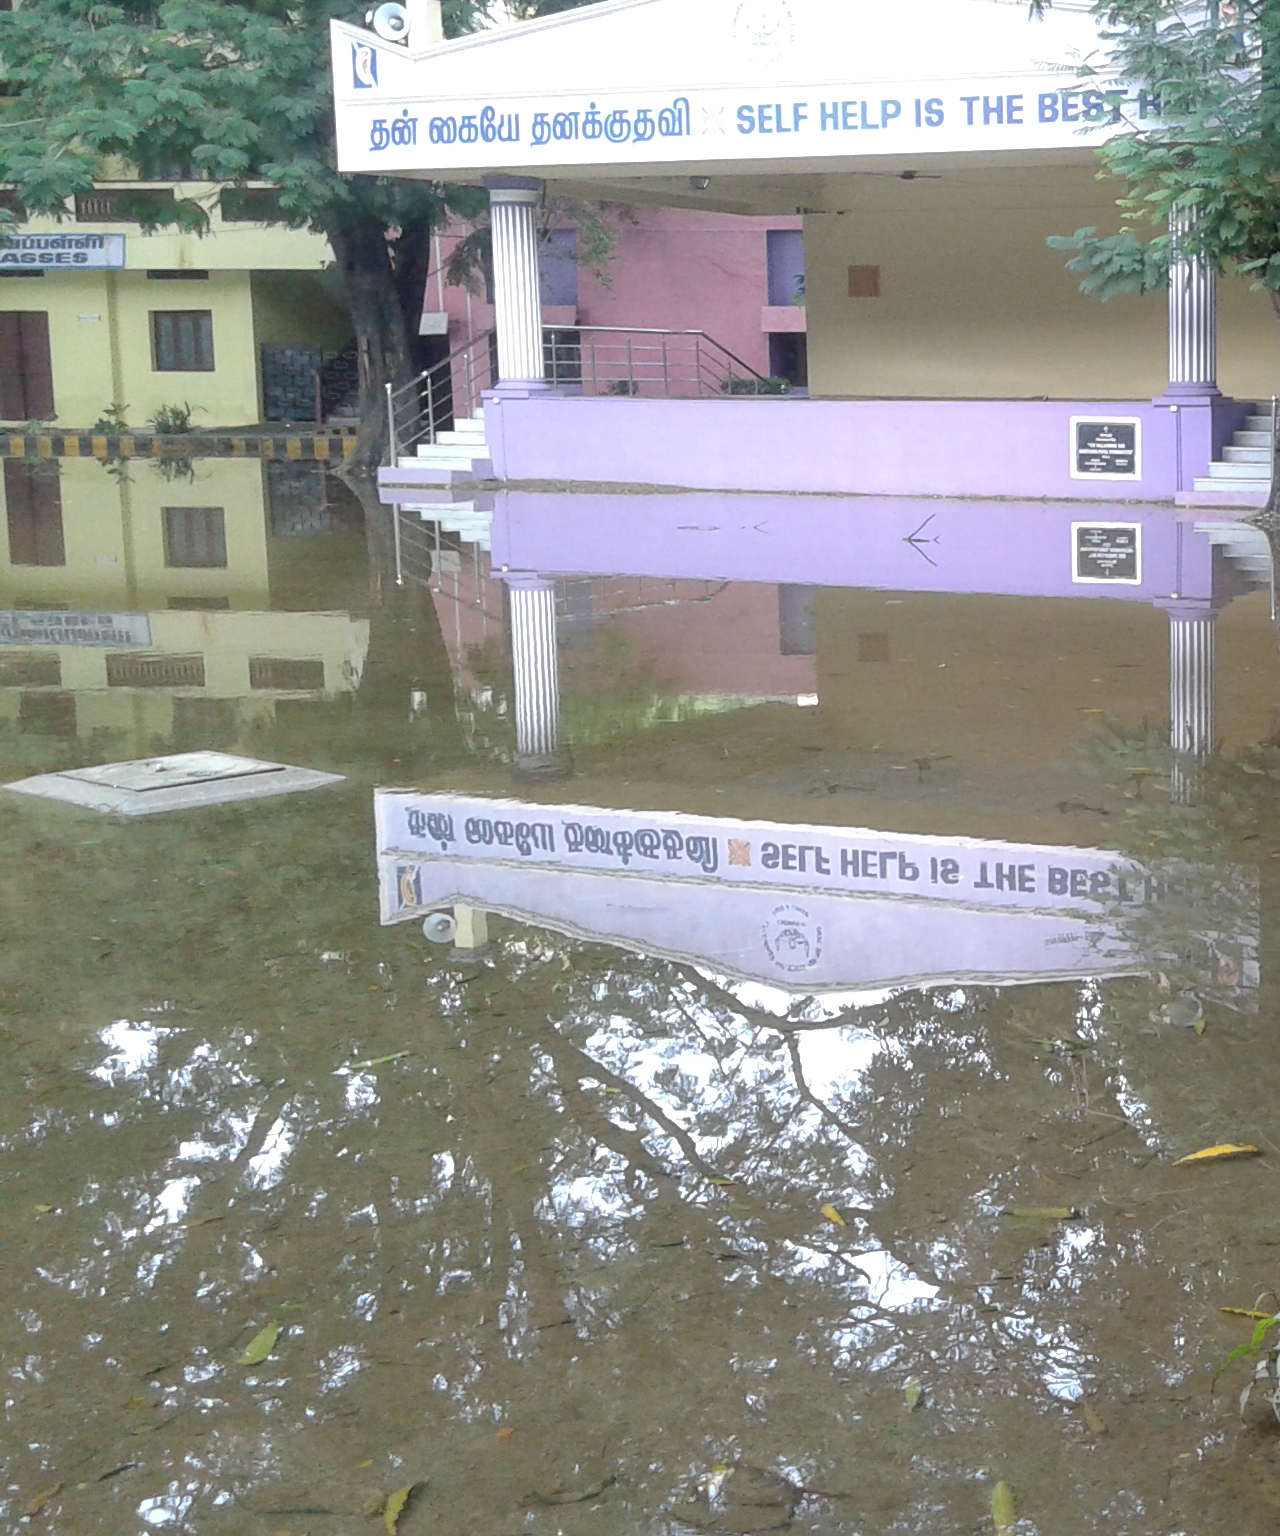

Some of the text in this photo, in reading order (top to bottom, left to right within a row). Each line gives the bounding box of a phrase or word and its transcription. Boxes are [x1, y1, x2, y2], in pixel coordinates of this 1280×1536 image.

[368, 97, 691, 152] தன் கையே தனக்குதவி
[736, 103, 808, 135] SELF
[820, 99, 902, 131] HELP
[915, 98, 945, 128] IS
[960, 94, 1023, 126] THE
[1037, 89, 1129, 124] BEST
[0, 252, 88, 264] ASSES
